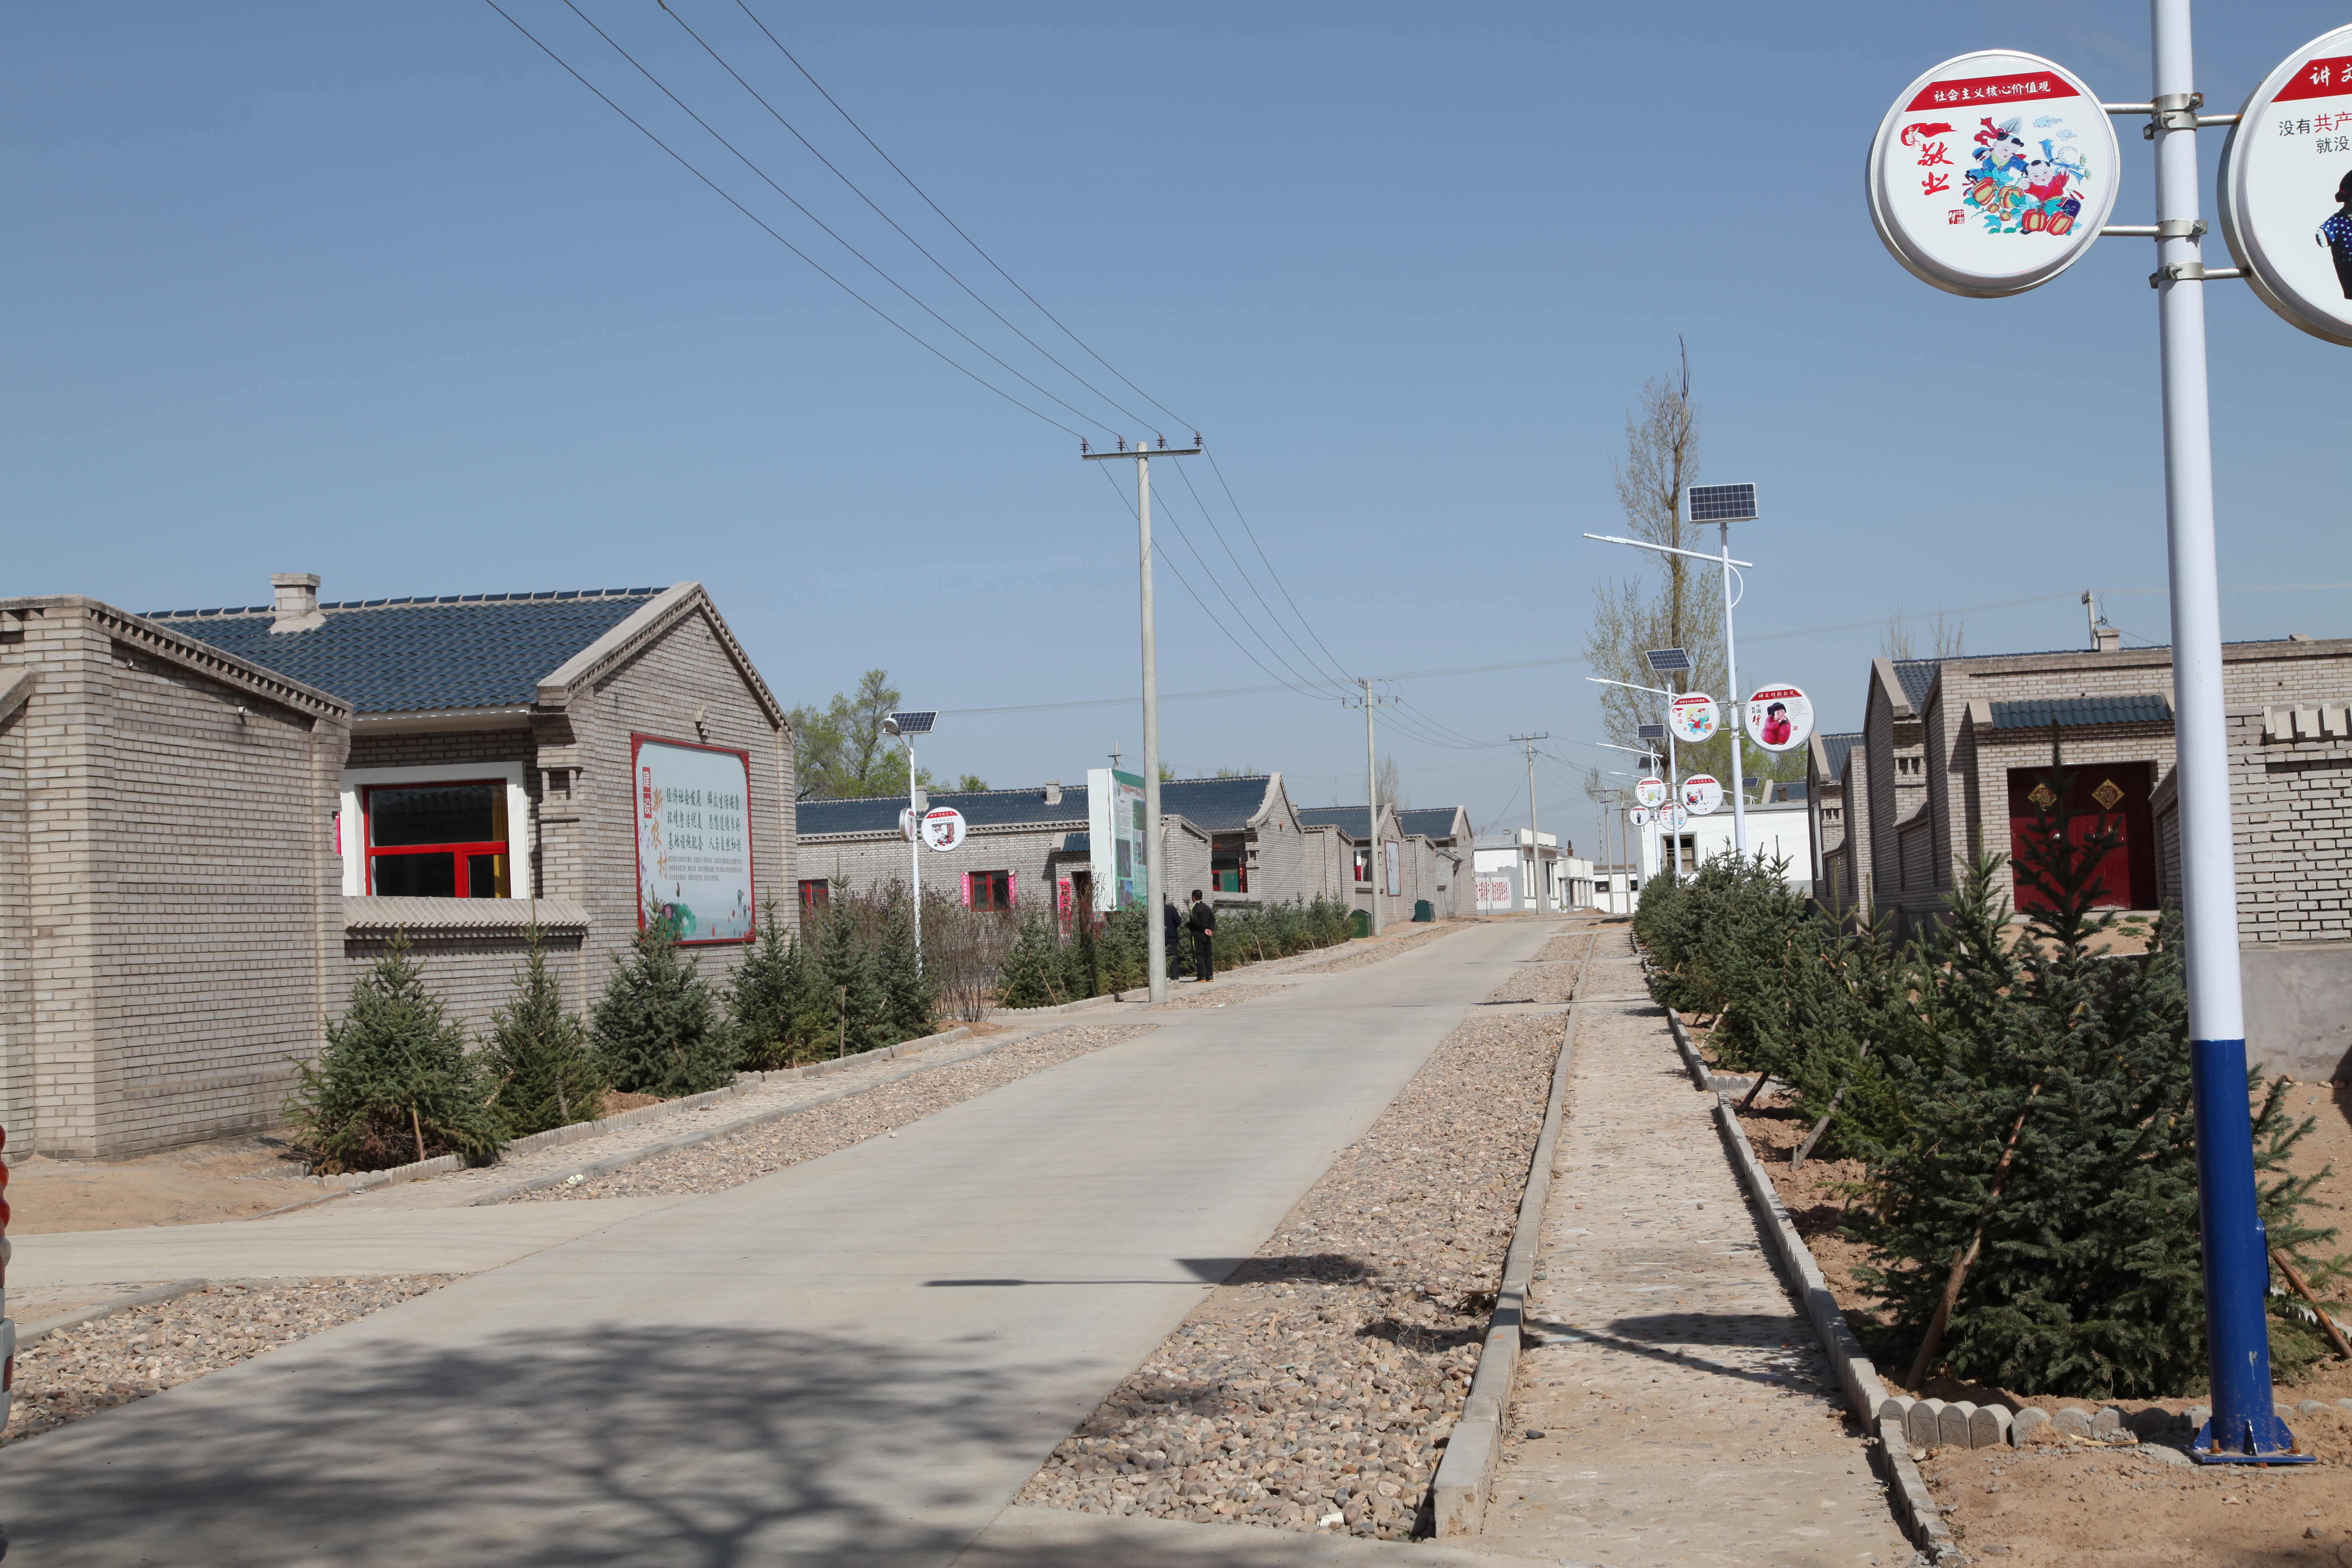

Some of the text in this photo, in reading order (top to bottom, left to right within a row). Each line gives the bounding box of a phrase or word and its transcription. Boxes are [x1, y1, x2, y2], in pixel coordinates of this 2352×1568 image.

[1934, 81, 2050, 102] 社会主义核心价值观
[2279, 111, 2352, 136] 没有共产
[2316, 136, 2352, 154] 就没
[1917, 142, 1955, 195] 敬业
[643, 771, 651, 815] 建设
[667, 787, 739, 811] 经济社会发展 群众生活安康
[668, 809, 740, 831] 环境整洁优美 思想道德良好
[651, 786, 668, 879] 新农村
[669, 831, 740, 852] 基础设施配套 人与自然和谐
